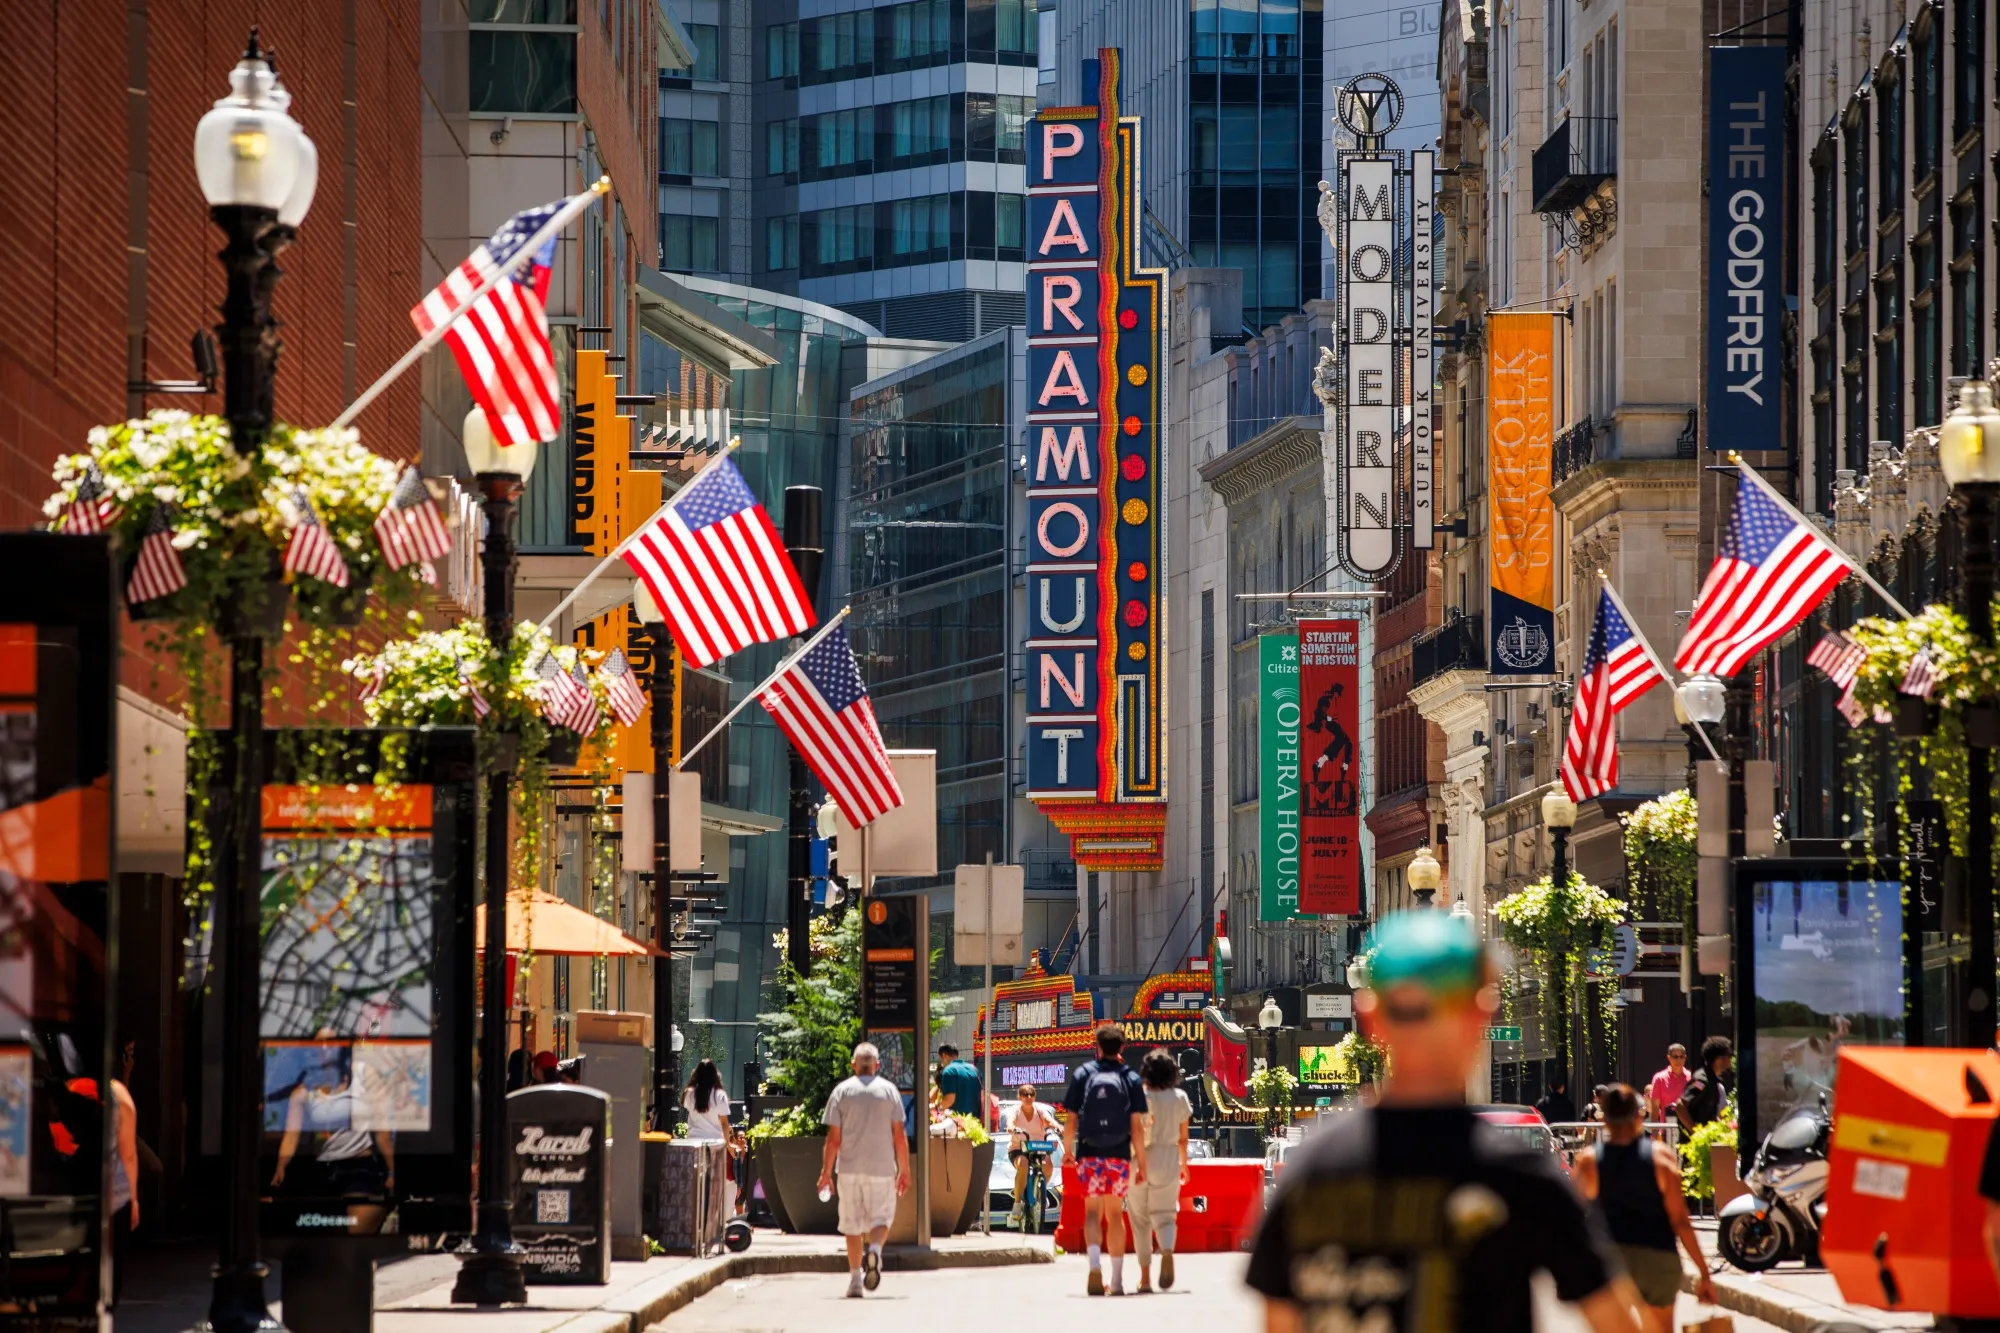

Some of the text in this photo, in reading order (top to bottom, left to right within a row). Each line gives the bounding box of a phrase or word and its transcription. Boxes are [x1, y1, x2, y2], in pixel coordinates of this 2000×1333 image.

[1726, 91, 1766, 406] THE GODFREY
[1351, 184, 1391, 529] MODERN
[1416, 198, 1430, 509] SUFFOLK UNIVERSITY
[1036, 123, 1091, 785] PARAMOUNT
[1494, 348, 1527, 570] SUFFOLK
[1527, 348, 1551, 569] UNIVERSITY
[1300, 643, 1357, 654] SOMETHIN'
[1302, 655, 1356, 666] IN BOSTON
[1306, 631, 1352, 643] STARTIN'
[1277, 702, 1300, 906] OPERA HOUSE
[1305, 836, 1335, 845] JUNE
[1337, 836, 1347, 844] 18
[1311, 848, 1348, 858] JULY 7
[515, 1126, 593, 1155] Laced
[296, 1213, 358, 1227] JCDecaux
